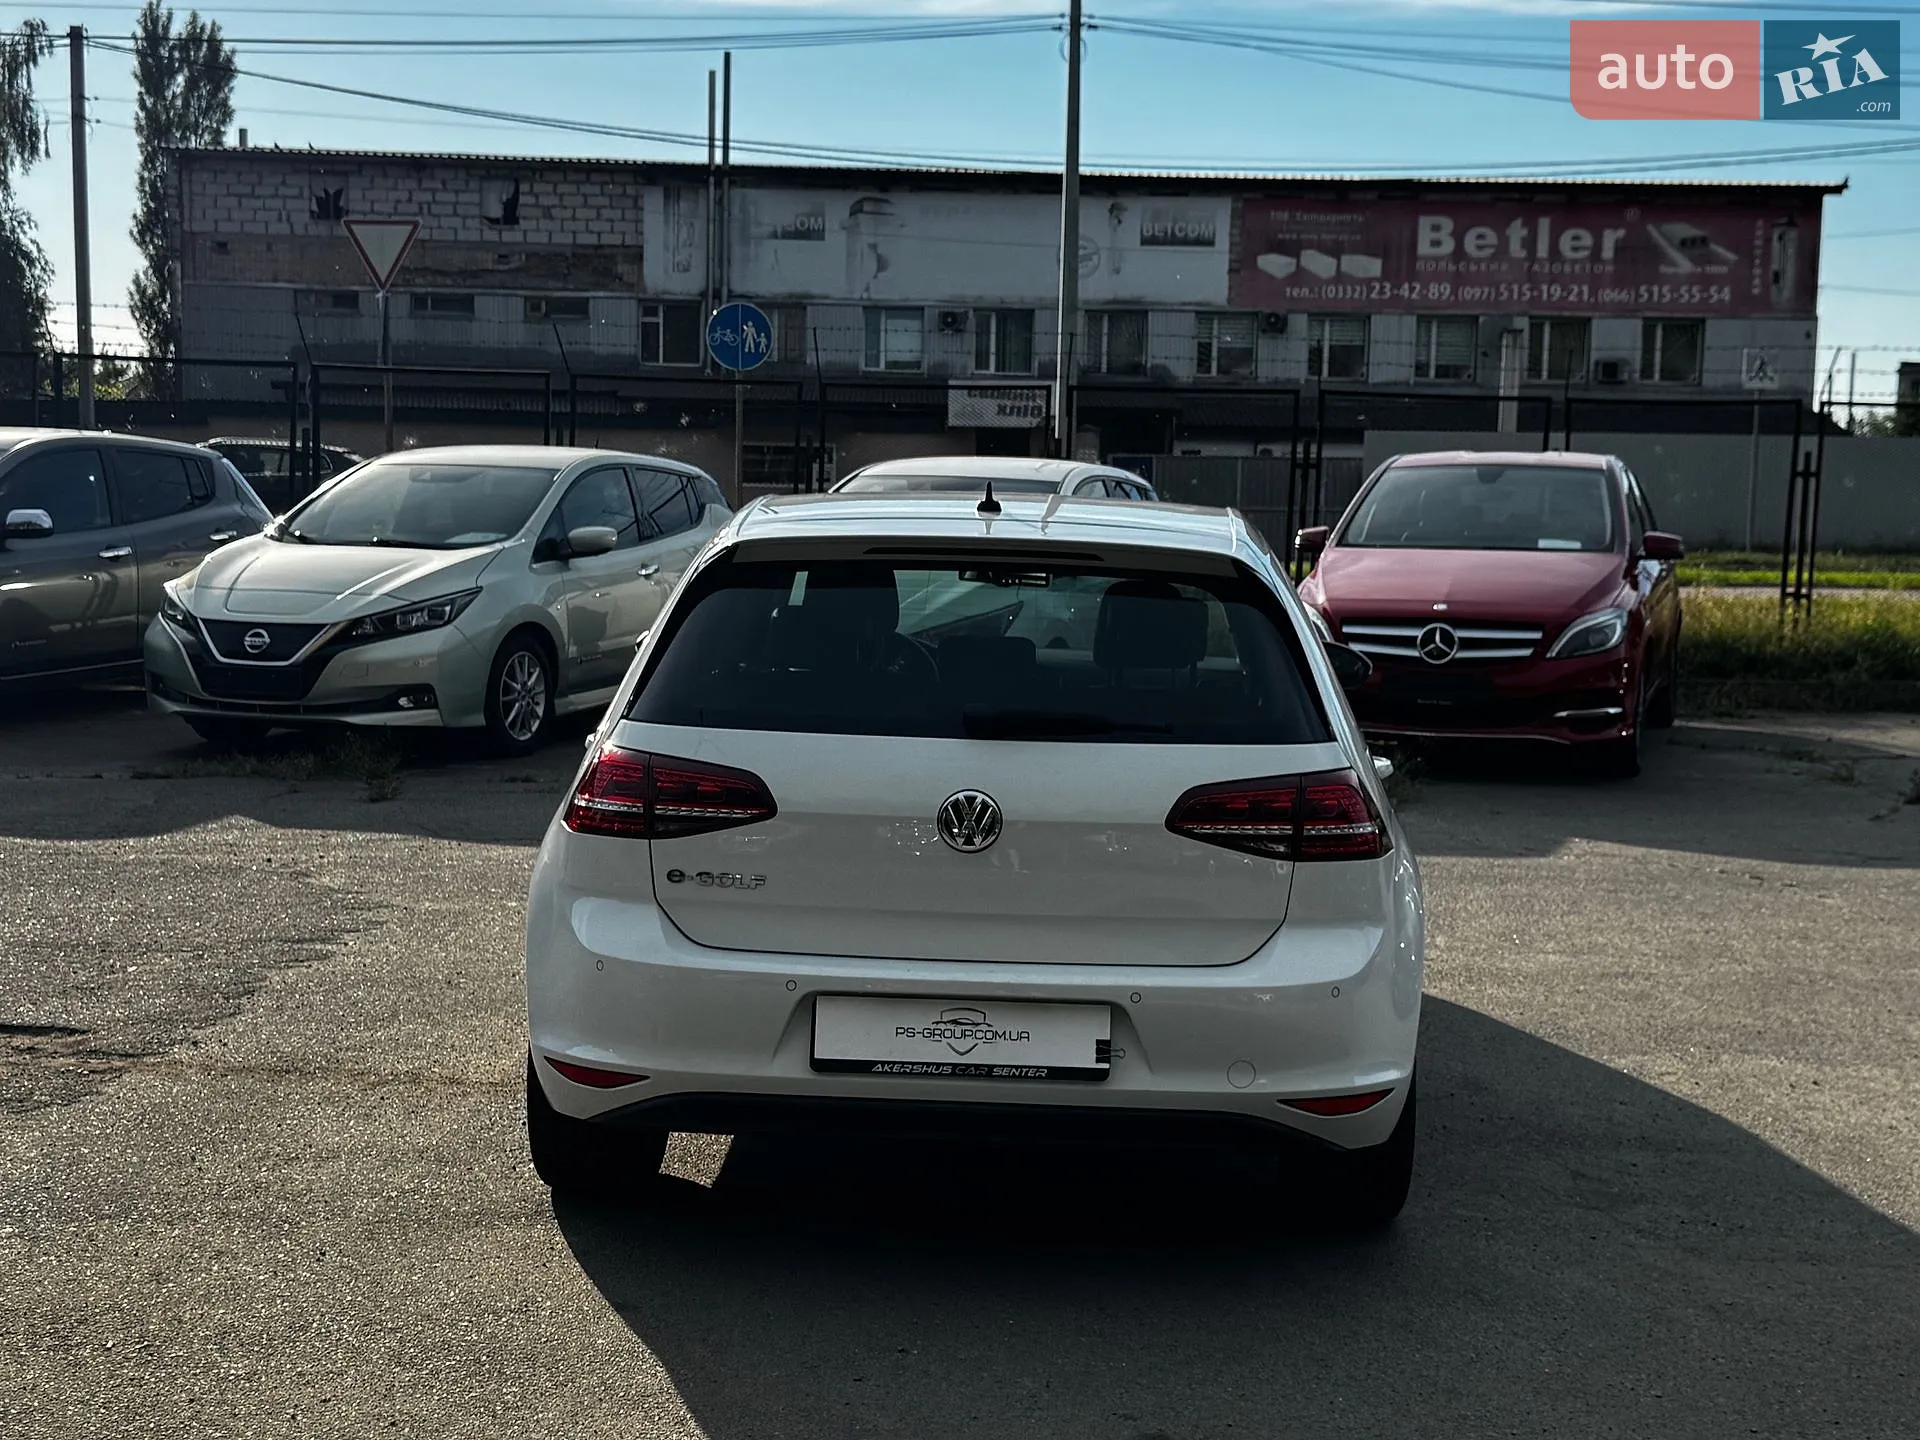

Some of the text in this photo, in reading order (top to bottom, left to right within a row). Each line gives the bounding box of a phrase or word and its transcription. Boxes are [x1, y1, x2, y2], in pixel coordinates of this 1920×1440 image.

[1416, 214, 1627, 261] Betler
[1369, 281, 1455, 302] 23-42-89,
[1637, 284, 1731, 304] 515-55-54
[894, 1026, 1031, 1044] PS-GROUP.COM.UA
[871, 1062, 1049, 1079] AKERSHUS CAR SENTER
